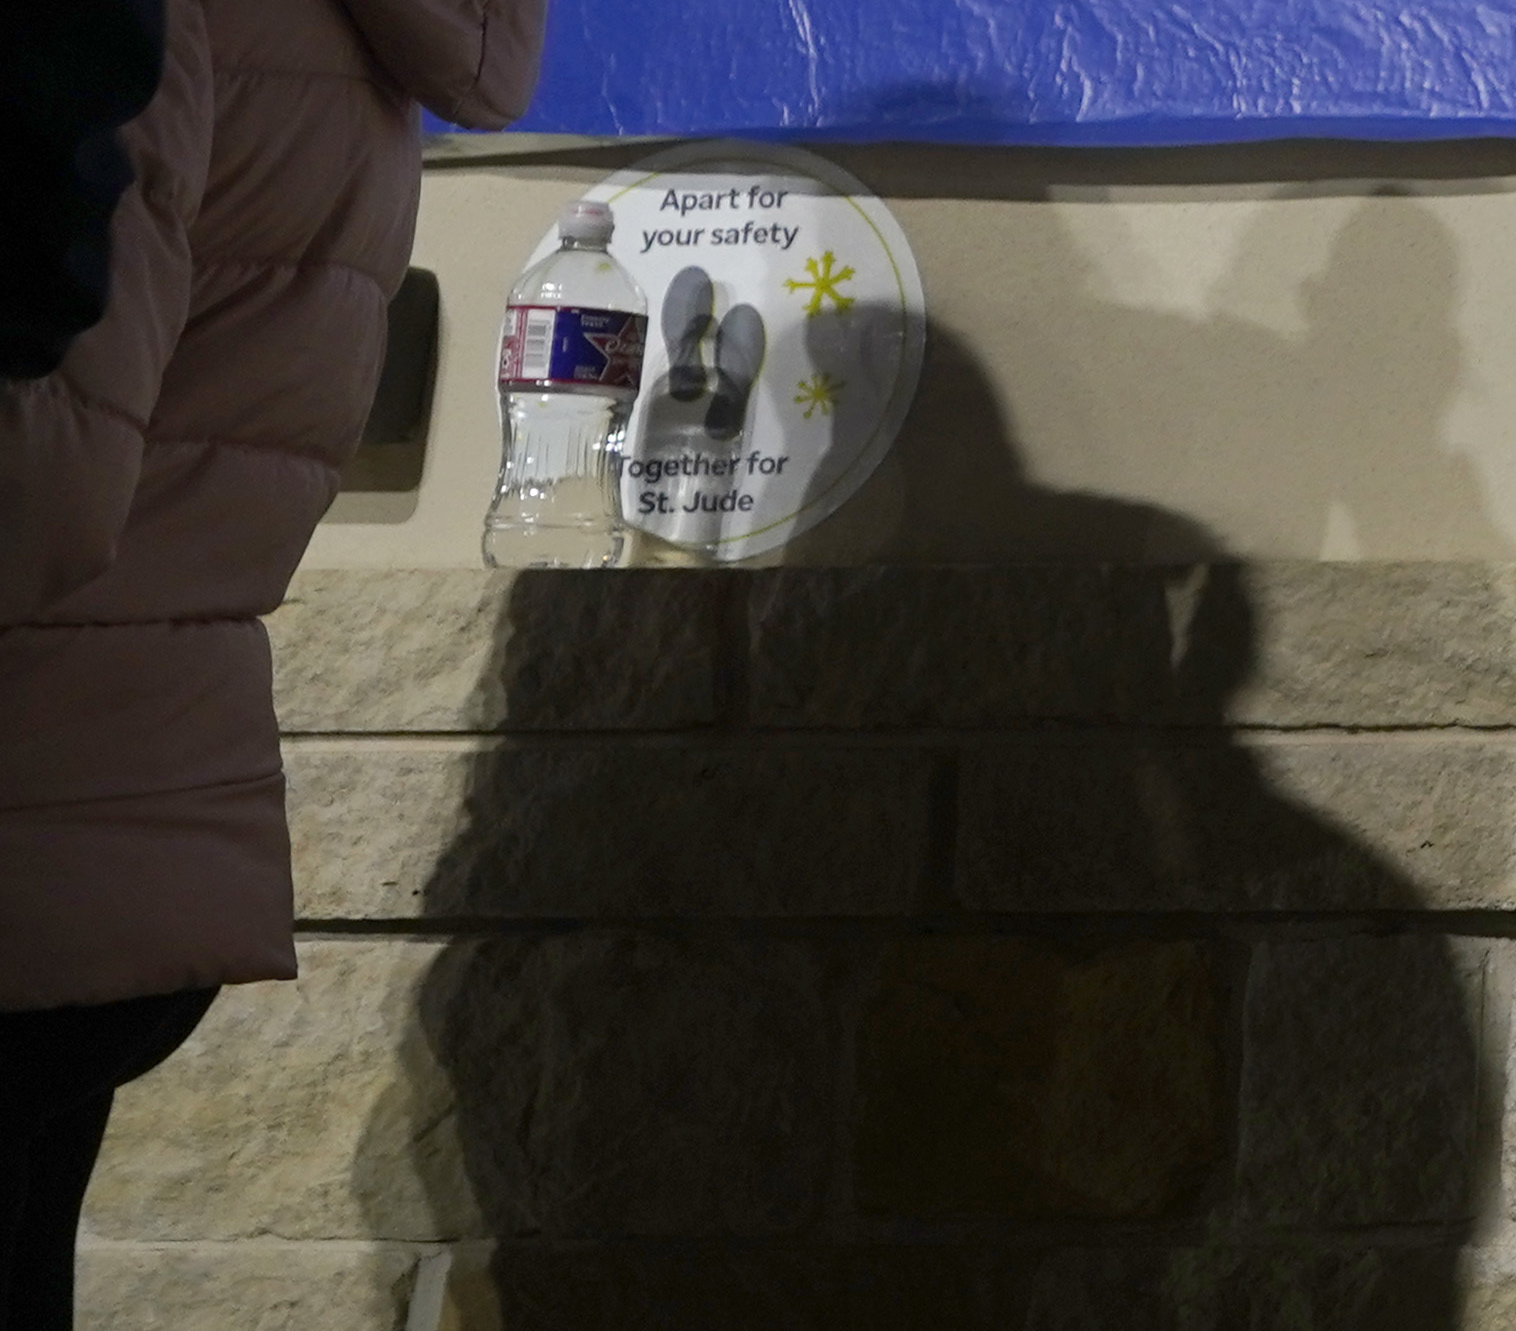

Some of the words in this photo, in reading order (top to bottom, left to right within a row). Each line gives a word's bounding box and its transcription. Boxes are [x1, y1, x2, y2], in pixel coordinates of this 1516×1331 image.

[660, 188, 740, 216] Apart
[748, 185, 789, 209] for
[640, 226, 706, 253] your
[710, 221, 800, 250] safety
[615, 452, 742, 484] Together
[747, 450, 790, 476] for
[637, 490, 677, 515] St.
[682, 489, 755, 514] Jude
